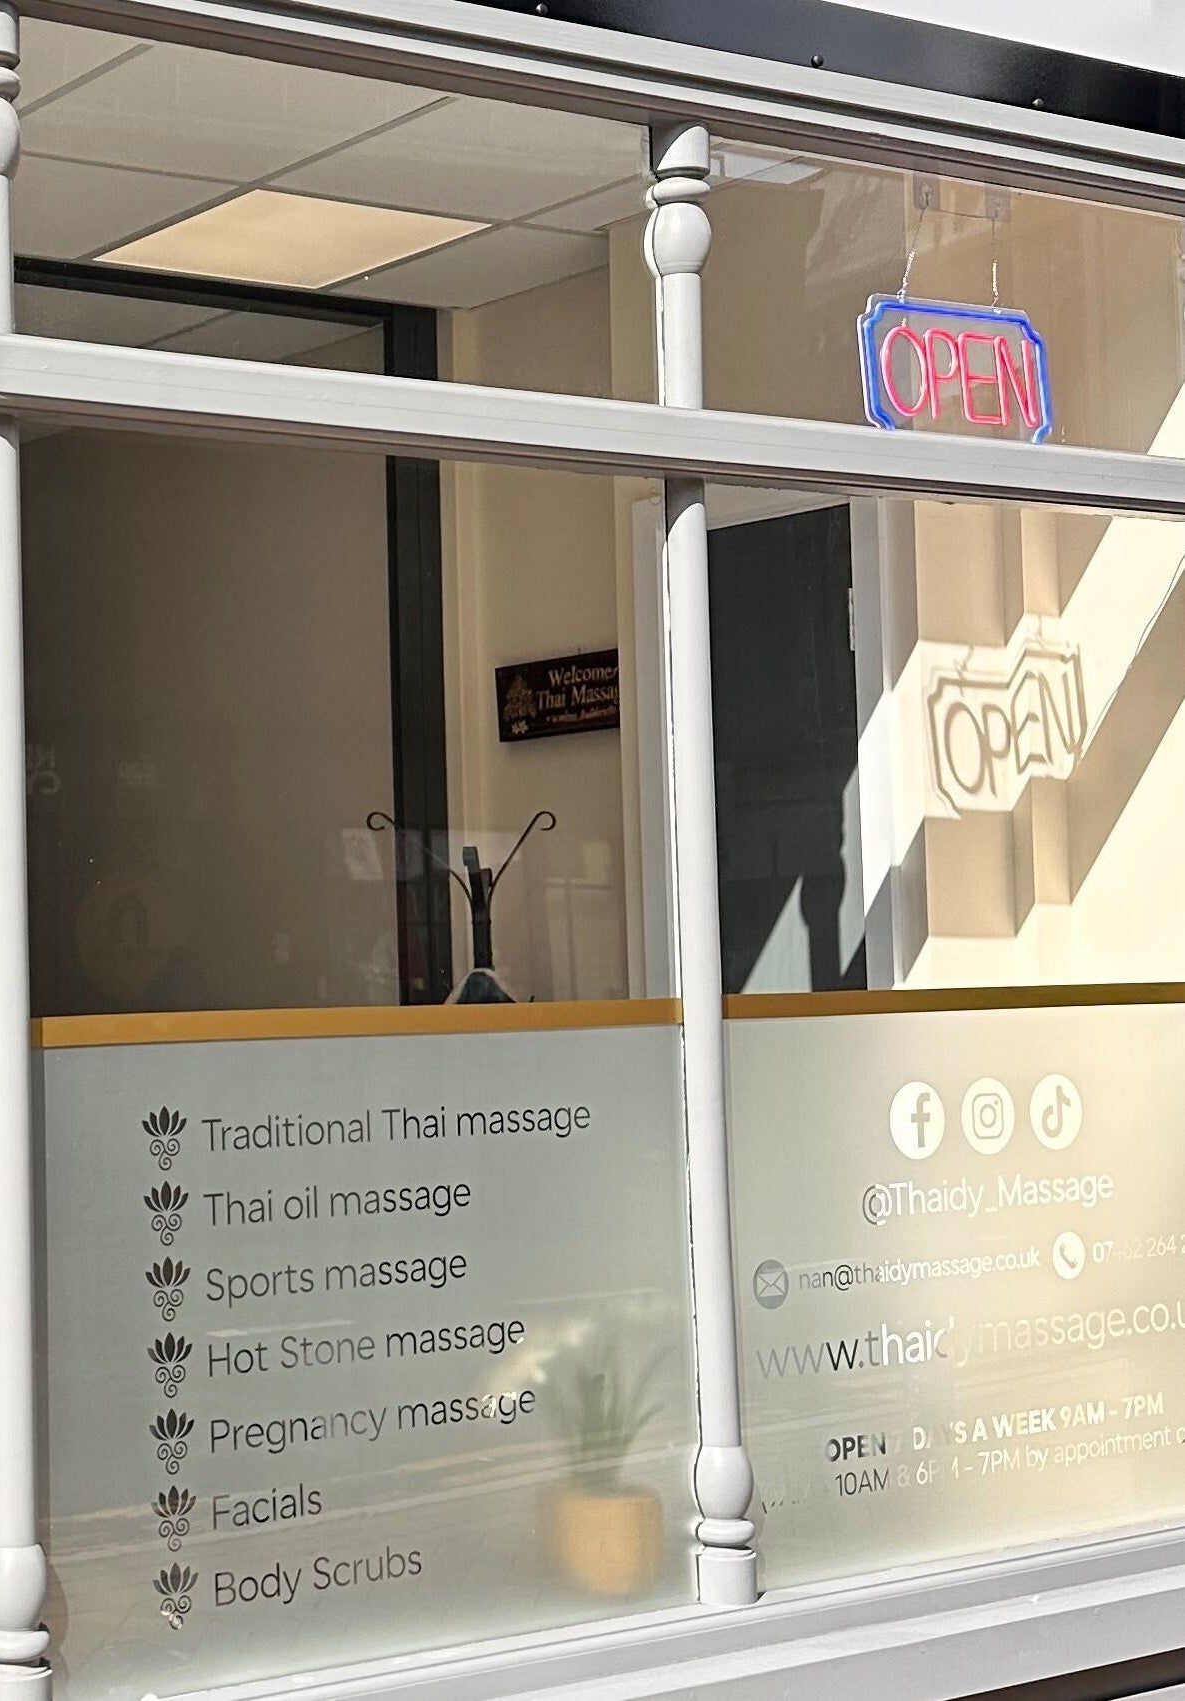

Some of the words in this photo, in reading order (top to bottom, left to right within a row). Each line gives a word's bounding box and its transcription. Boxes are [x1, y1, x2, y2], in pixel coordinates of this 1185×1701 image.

[881, 326, 1040, 428] OPEN
[536, 688, 566, 710] Thai
[548, 665, 618, 687] Welcome
[944, 671, 1077, 800] OPEN
[202, 1109, 371, 1151] Traditional
[381, 1106, 446, 1141] Thai
[457, 1105, 591, 1138] massage
[204, 1190, 272, 1227] Thai
[284, 1185, 318, 1220] oil
[330, 1183, 471, 1217] massage
[862, 1173, 1114, 1226] @Thaidy_Massage
[799, 1245, 1040, 1292] nan@thaidymassage.co.uk
[1147, 1233, 1177, 1258] 264
[206, 1262, 314, 1308] Sports
[325, 1254, 467, 1290] massage
[208, 1340, 268, 1377] Hot
[280, 1335, 375, 1370] Stone
[386, 1319, 525, 1357] massage
[211, 1405, 386, 1454] Pregnancy
[398, 1389, 536, 1430] massage
[825, 1432, 886, 1463] OPEN
[972, 1417, 988, 1442] A
[992, 1407, 1057, 1439] WEEK
[1059, 1400, 1105, 1429] 9AM
[1121, 1392, 1164, 1420] 7PM
[835, 1467, 891, 1496] 10AM
[896, 1463, 911, 1488] &
[977, 1446, 1021, 1476] 7PM
[1026, 1444, 1049, 1472] by
[1054, 1424, 1172, 1467] appointment
[212, 1483, 322, 1530] Facials
[215, 1562, 302, 1607] Body
[313, 1545, 422, 1591] Scrubs
